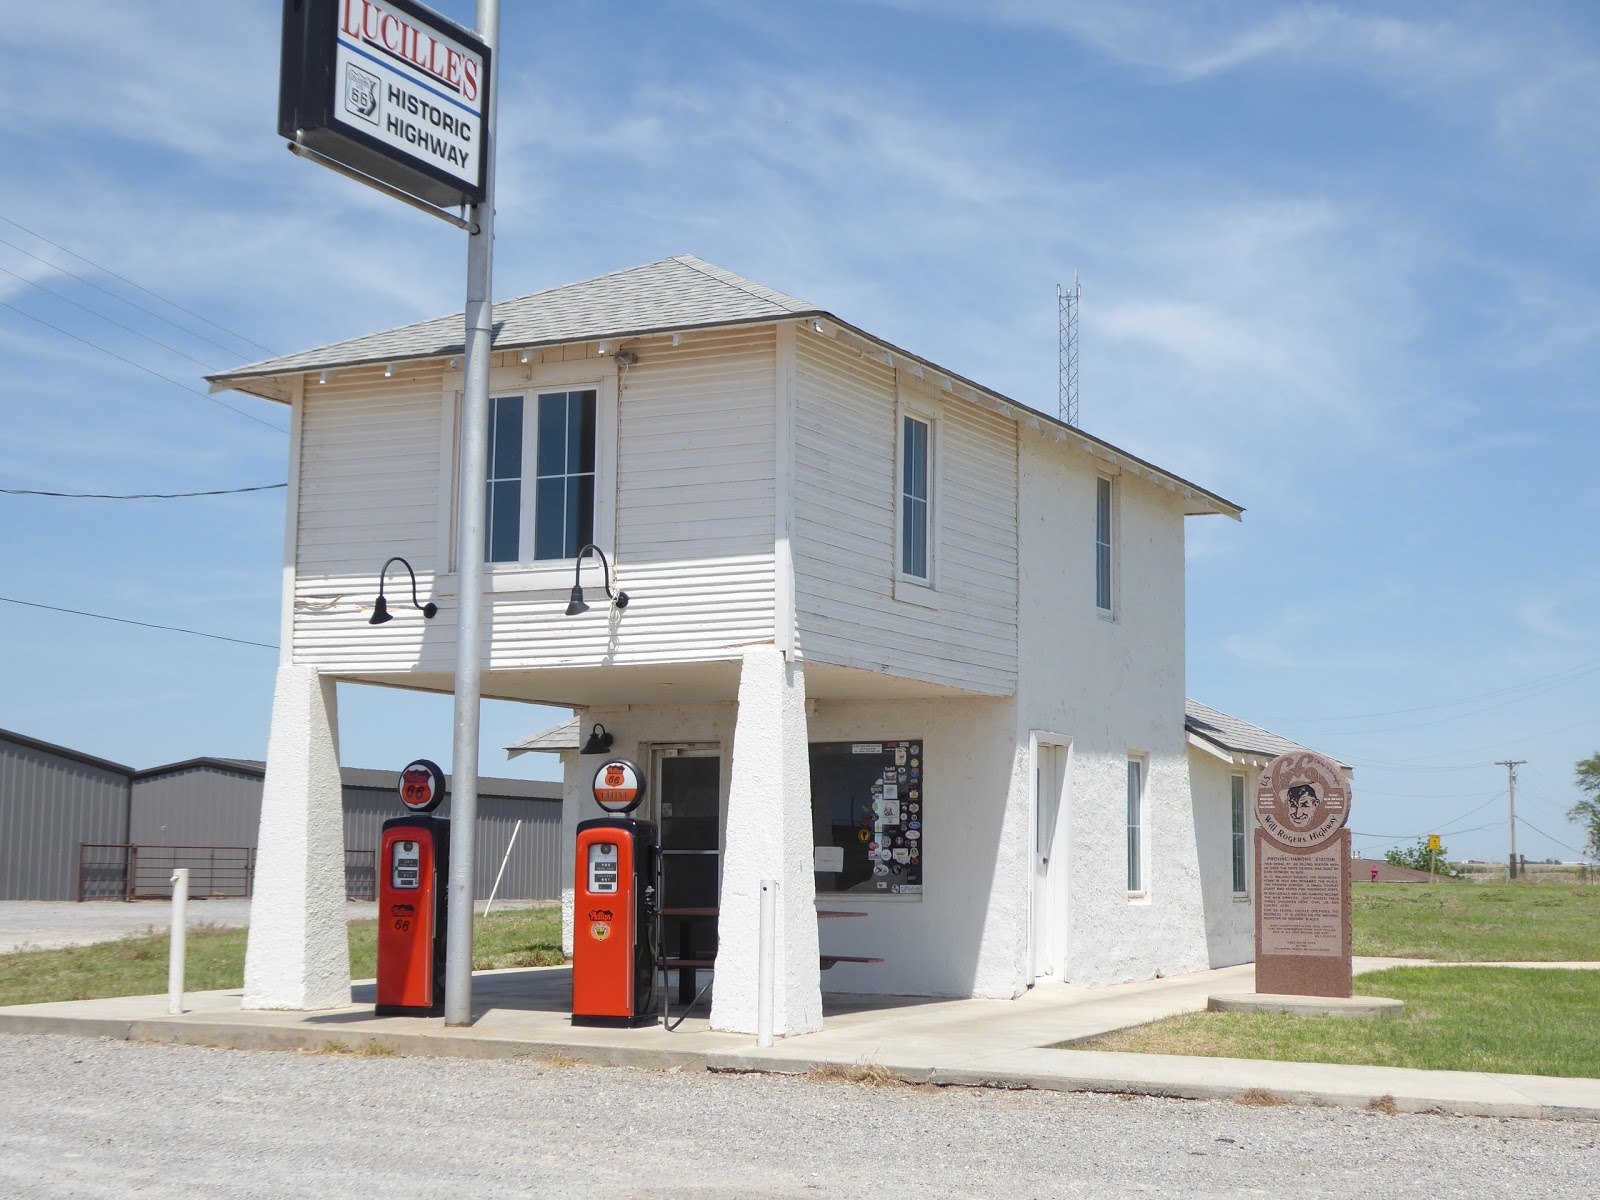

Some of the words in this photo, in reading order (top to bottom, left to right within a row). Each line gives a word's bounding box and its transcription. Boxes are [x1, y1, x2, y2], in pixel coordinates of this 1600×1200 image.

[341, 0, 478, 102] LUCILLE'S
[352, 88, 368, 107] 66
[387, 82, 472, 142] HISTORIC
[386, 112, 469, 169] HIGHWAY
[608, 776, 620, 784] 66
[406, 785, 425, 800] 66
[1264, 814, 1278, 832] Will
[1309, 815, 1338, 841] Highway
[395, 919, 410, 932] 66
